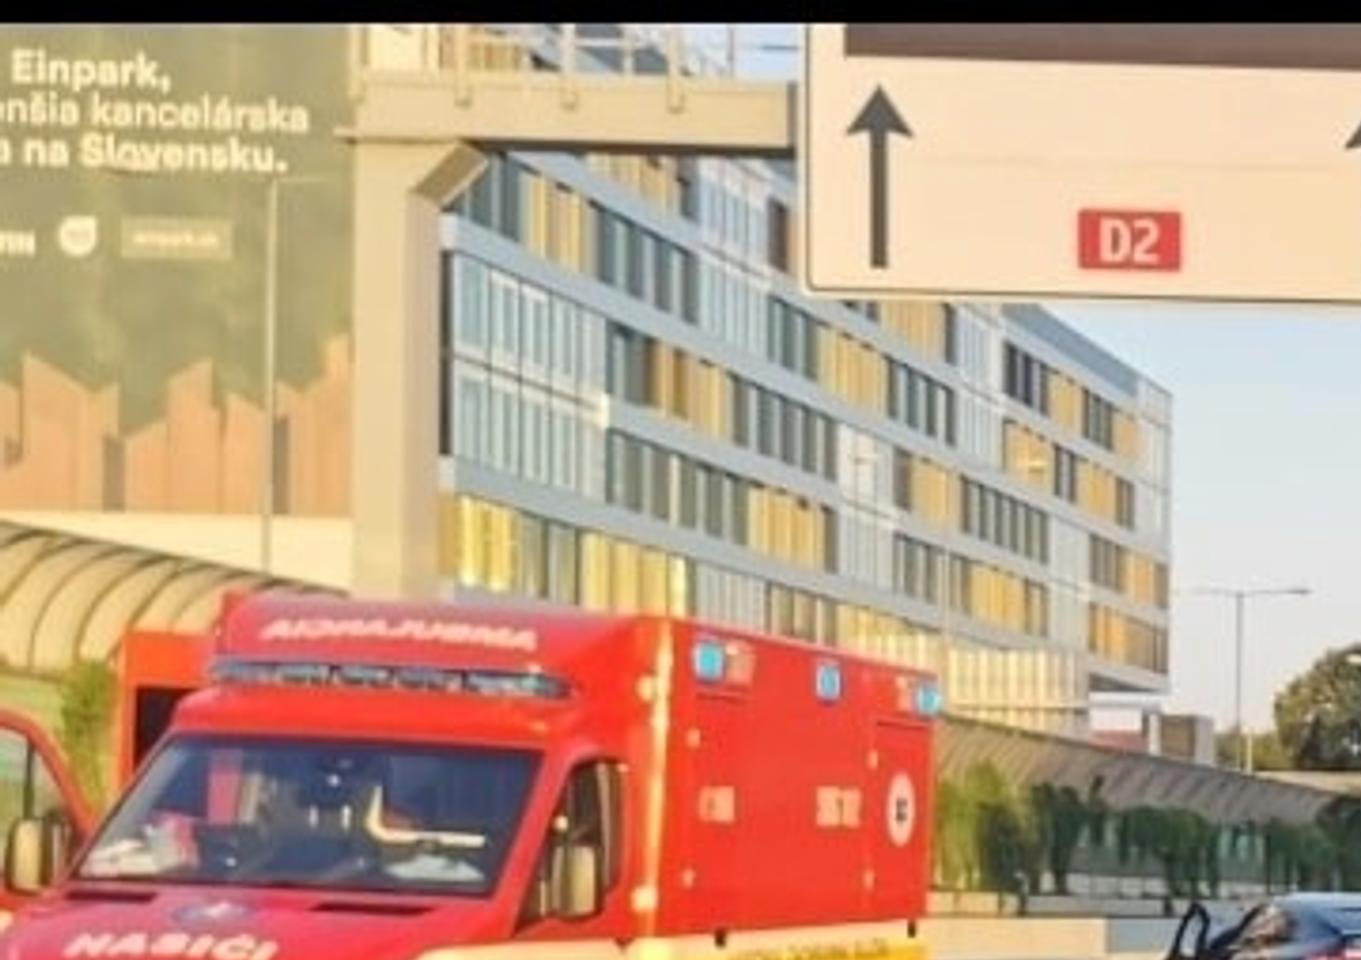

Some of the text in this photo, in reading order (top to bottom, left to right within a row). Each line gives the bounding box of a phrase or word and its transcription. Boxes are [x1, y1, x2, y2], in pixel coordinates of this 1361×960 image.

[11, 47, 171, 94] Einpark,
[91, 90, 310, 133] kancelárska
[23, 137, 70, 167] na
[79, 130, 289, 173] Slovensku.
[1099, 217, 1161, 263] D2
